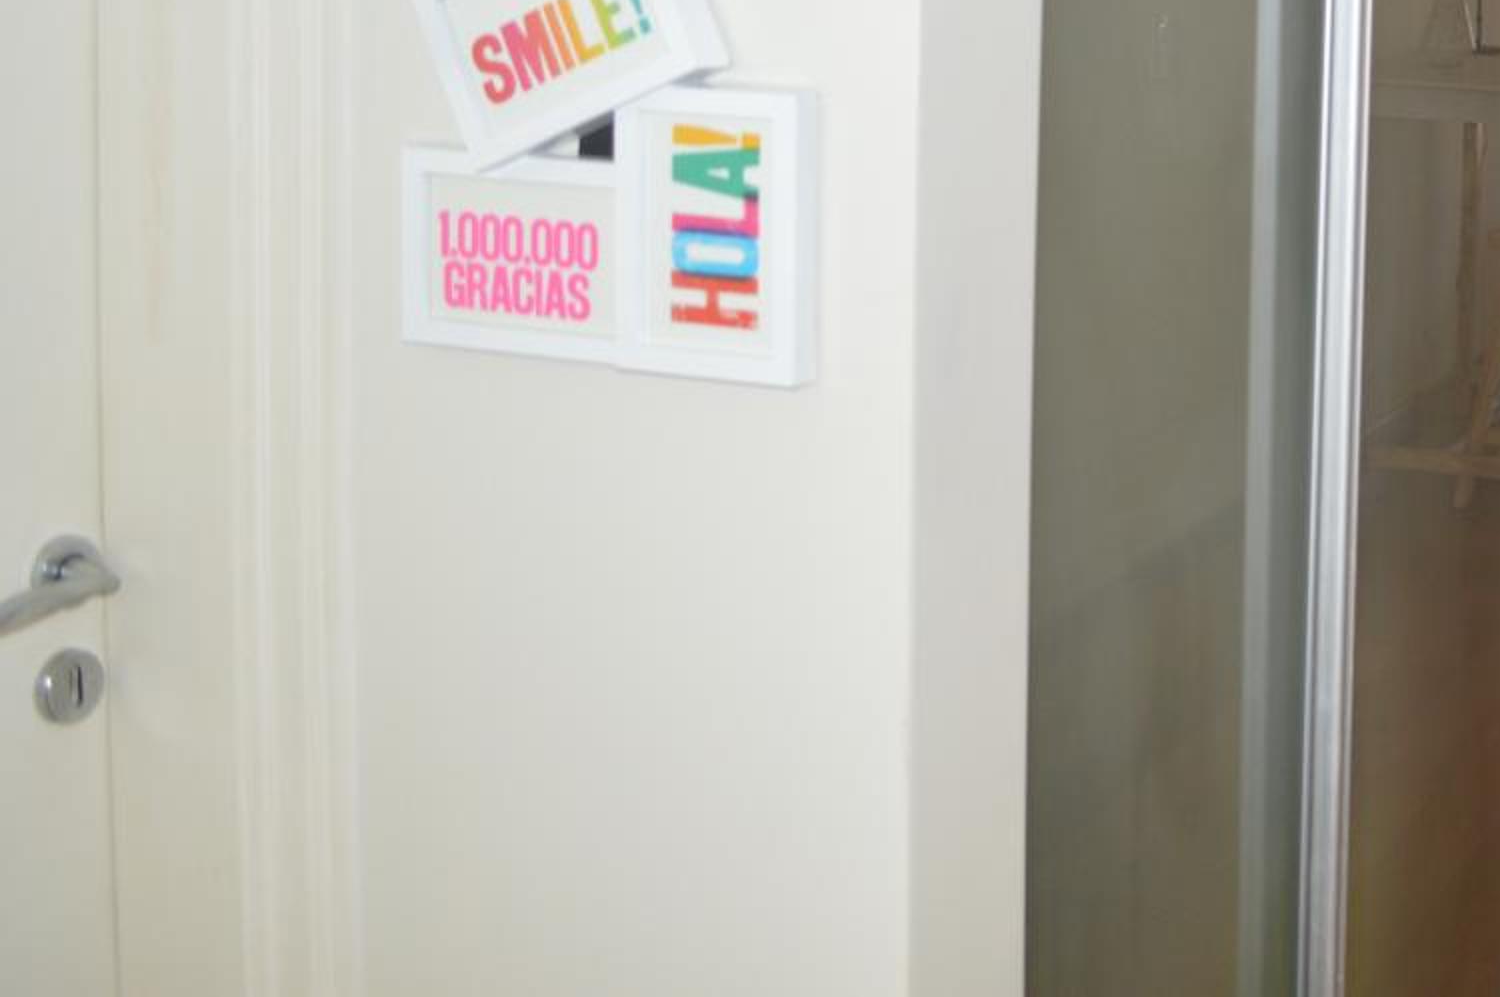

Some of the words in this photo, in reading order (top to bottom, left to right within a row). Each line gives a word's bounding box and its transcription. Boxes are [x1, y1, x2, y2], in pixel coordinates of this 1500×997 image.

[438, 209, 599, 271] 1.000.000
[671, 124, 760, 330] HOLA!
[443, 261, 591, 321] GRACIAS
